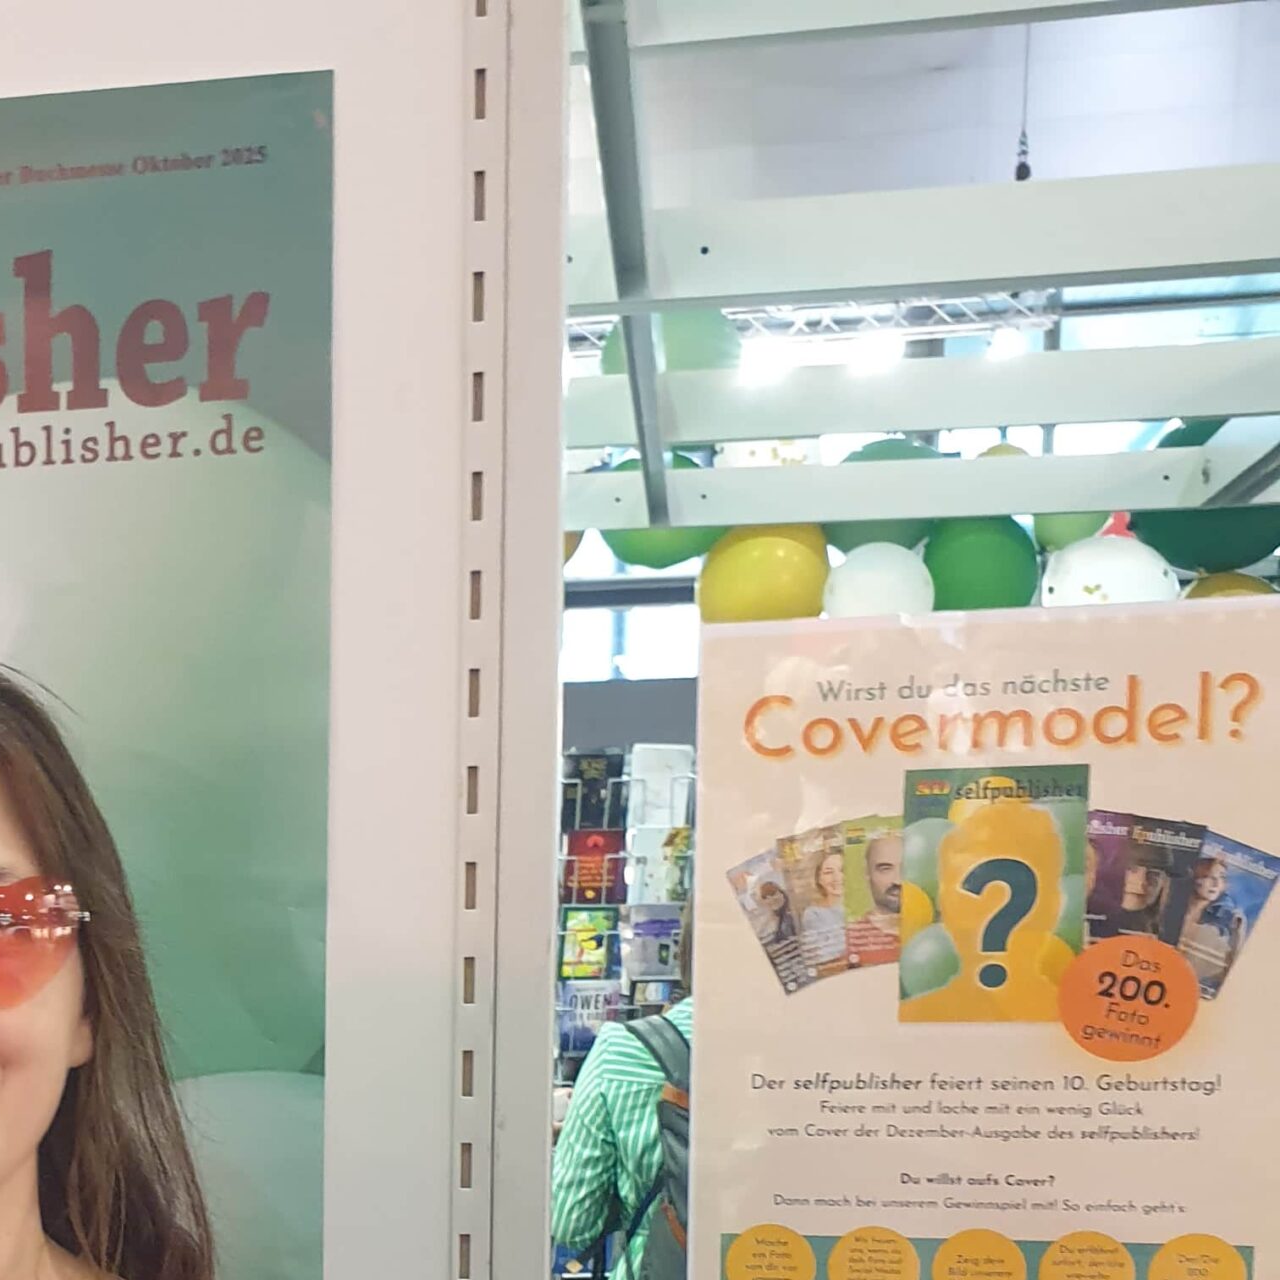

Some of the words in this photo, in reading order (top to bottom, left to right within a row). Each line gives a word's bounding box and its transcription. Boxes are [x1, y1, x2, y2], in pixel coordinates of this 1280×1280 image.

[20, 163, 125, 184] Buchmesse
[132, 153, 215, 175] Oktober
[221, 145, 268, 167] 2025
[817, 680, 887, 701] Wirst
[897, 675, 931, 700] du
[942, 673, 991, 698] das
[1002, 669, 1110, 695] nächste
[744, 671, 1263, 758] Covermodel?
[1121, 950, 1162, 973] Das
[569, 993, 613, 1010] OWEN
[1097, 971, 1170, 1009] 200.
[1105, 1002, 1150, 1026] Foto
[1082, 1024, 1162, 1050] gewinnt
[751, 1073, 786, 1090] Der
[793, 1072, 922, 1094] selfpublisher
[930, 1073, 984, 1090] feiert
[991, 1076, 1055, 1091] seinen
[1063, 1075, 1090, 1091] 10.
[1096, 1074, 1222, 1096] Geburtstag!
[820, 1100, 866, 1114] Feiere
[872, 1102, 896, 1114] mit
[903, 1101, 932, 1114] und
[984, 1102, 1010, 1115] mit
[1016, 1103, 1040, 1115] ein
[1047, 1103, 1093, 1118] wenig
[1098, 1101, 1144, 1116] Glück
[768, 1126, 799, 1137] vom
[804, 1123, 849, 1137] Cover
[854, 1124, 880, 1137] der
[886, 1124, 1041, 1142] Dezember-Ausgabe
[1047, 1126, 1074, 1140] des
[1080, 1126, 1200, 1142] selfpublishers!
[899, 1172, 921, 1185] Du
[926, 1173, 962, 1185] willst
[967, 1174, 999, 1187] aufs
[1004, 1174, 1056, 1188] Cover?
[773, 1194, 810, 1206] Dann
[814, 1196, 852, 1208] mach
[856, 1196, 876, 1208] bei
[882, 1198, 938, 1209] unserem
[943, 1197, 1026, 1212] Gewinnspiel
[1062, 1200, 1081, 1212] So
[1085, 1201, 1136, 1214] einfach
